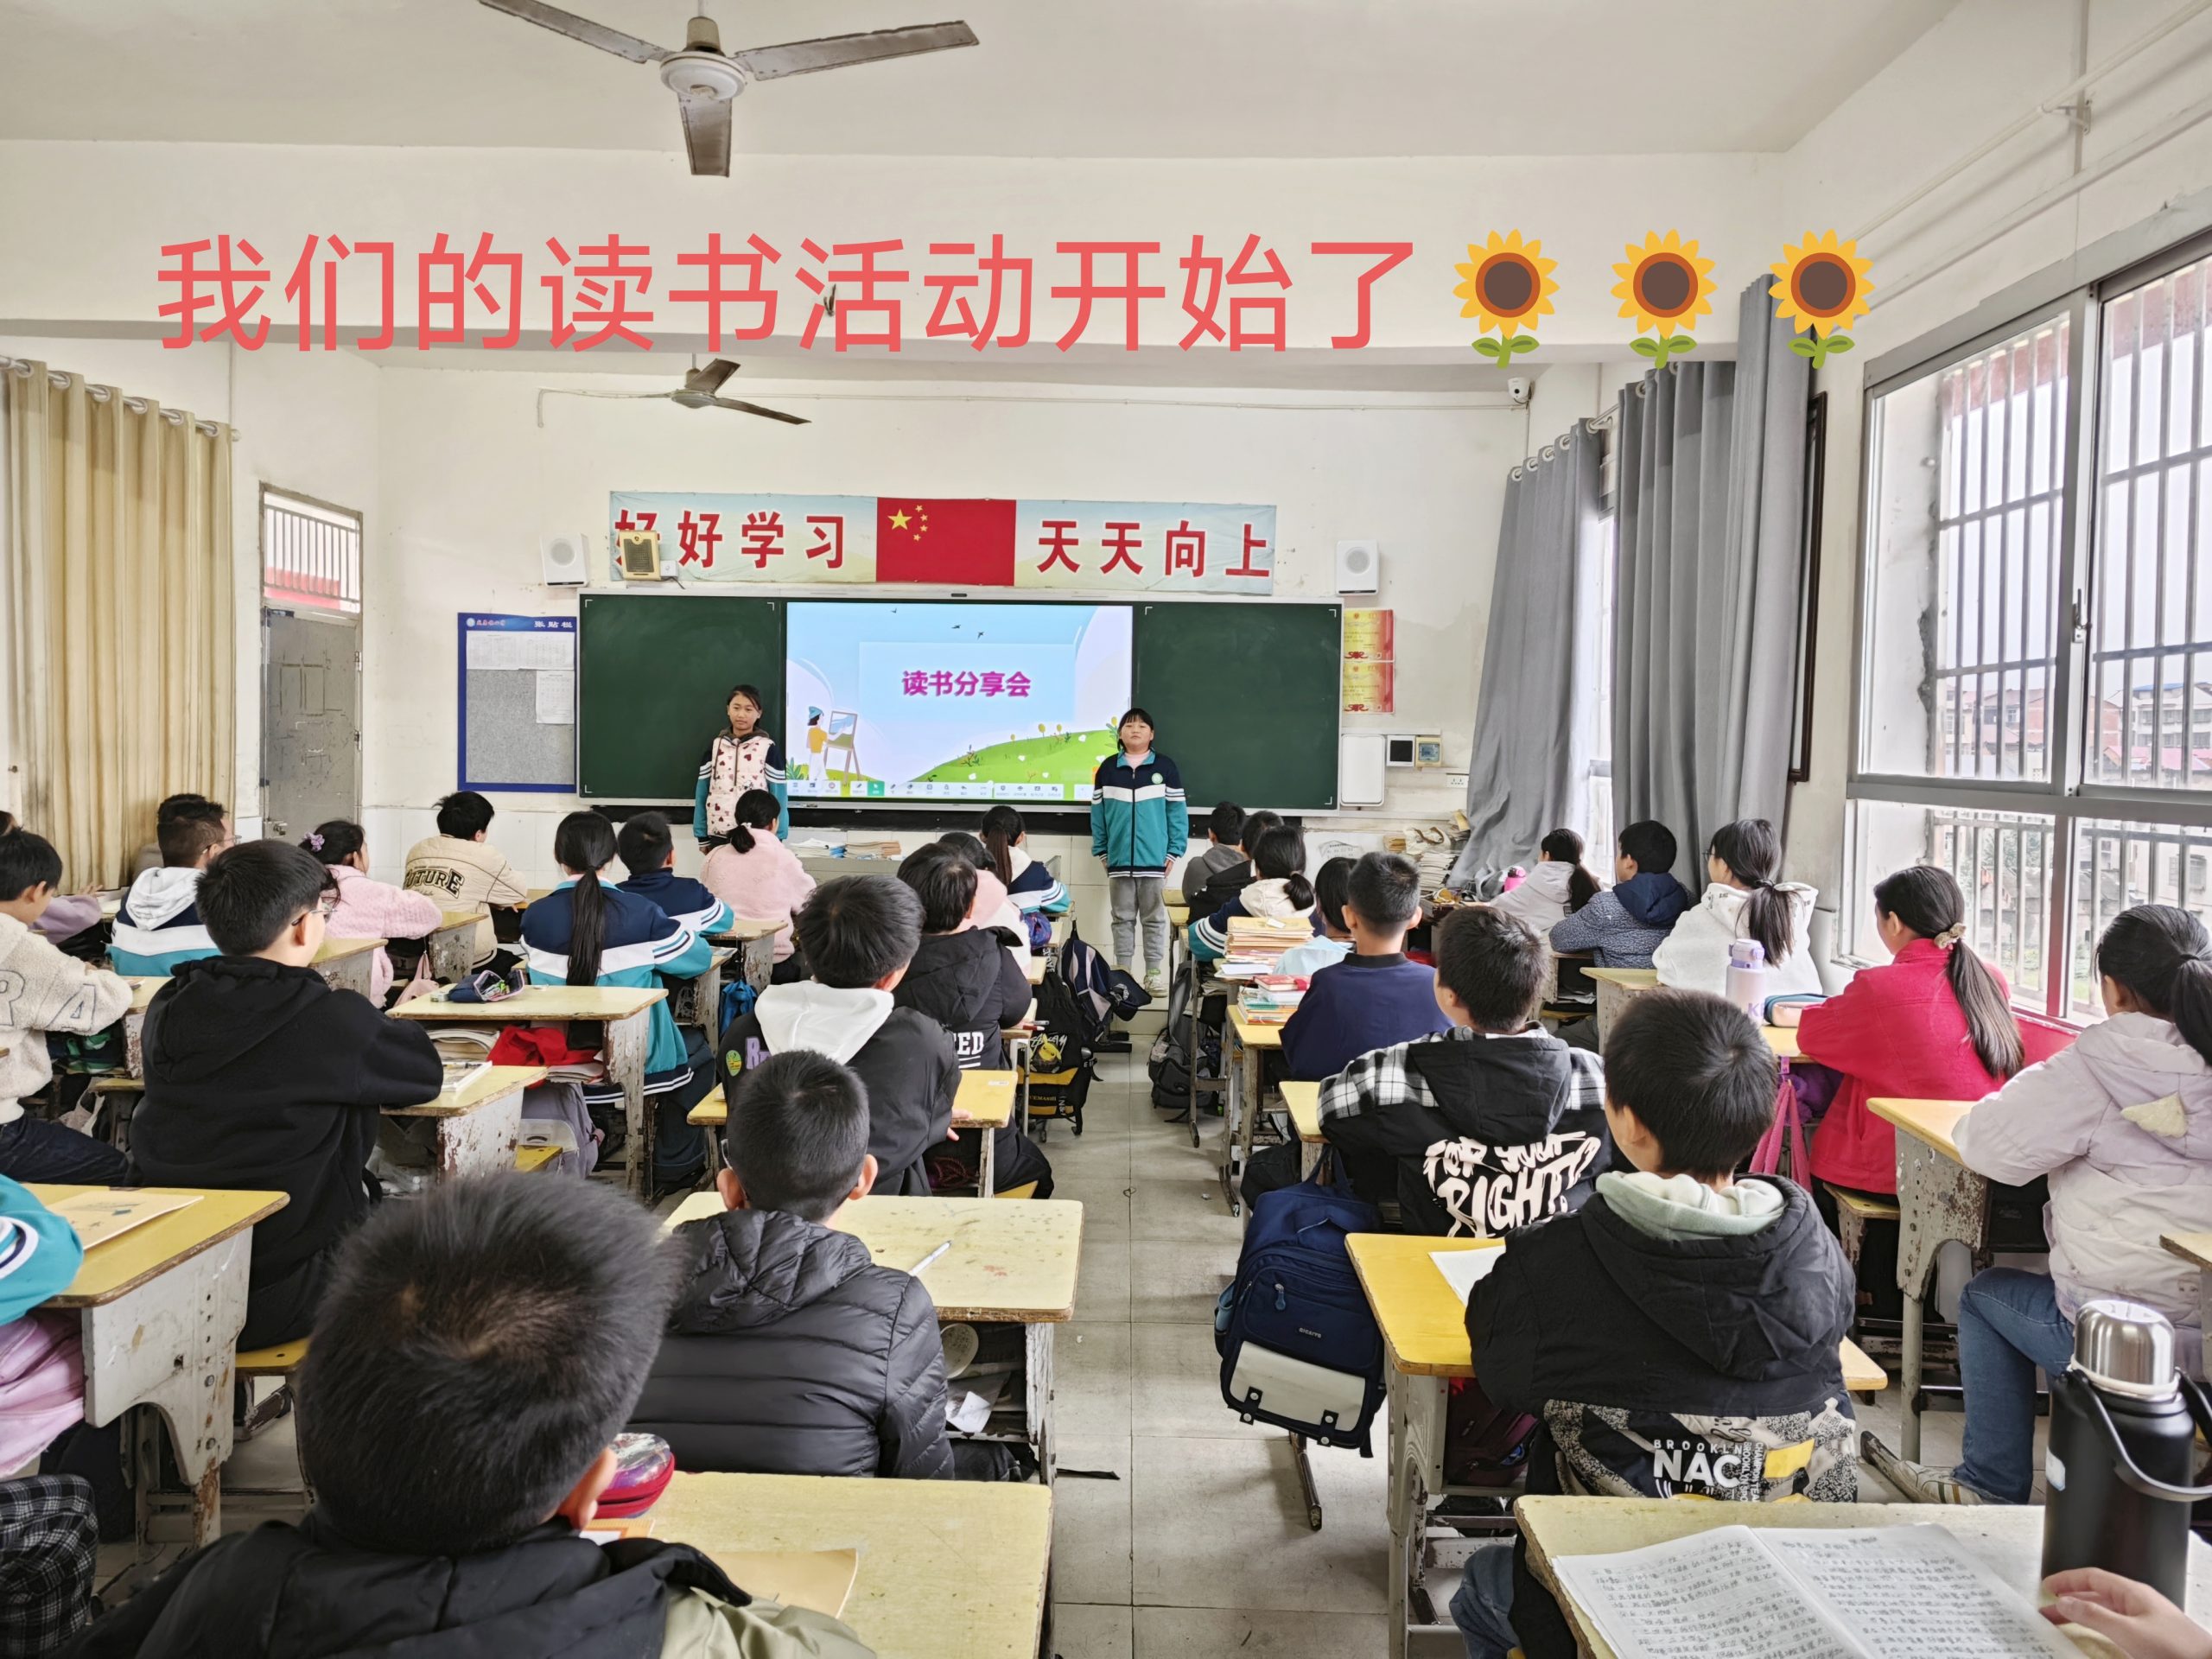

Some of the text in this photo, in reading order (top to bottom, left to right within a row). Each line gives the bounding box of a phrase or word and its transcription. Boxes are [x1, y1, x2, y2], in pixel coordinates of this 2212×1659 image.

[1037, 519, 1269, 578] 天天向上
[901, 670, 1032, 697] 读书分享会
[953, 1031, 984, 1056] ED
